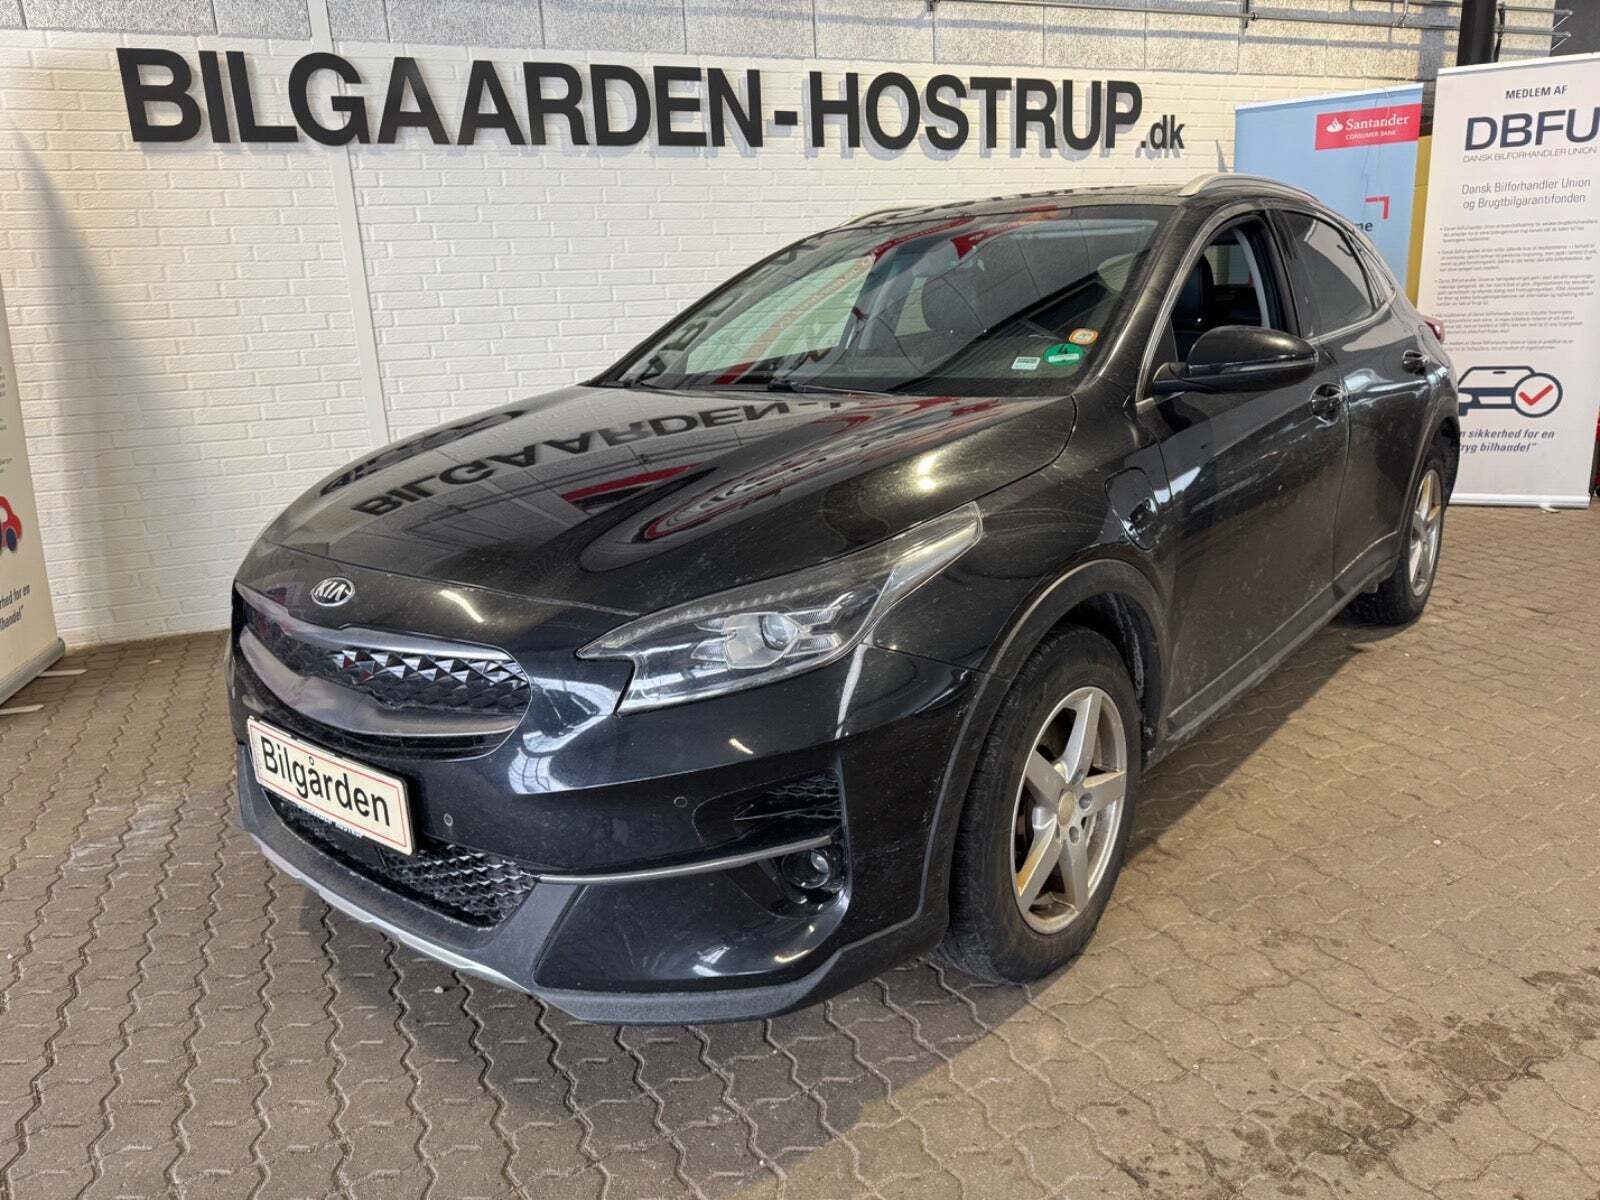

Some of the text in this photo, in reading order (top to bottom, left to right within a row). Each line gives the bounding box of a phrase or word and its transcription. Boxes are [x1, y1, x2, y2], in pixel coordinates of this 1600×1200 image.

[1504, 84, 1568, 100] MEDLEM AF
[1345, 113, 1410, 131] Santander
[1464, 105, 1600, 151] DBFU
[1462, 145, 1598, 164] DANSK BILFORHANDLER UNION
[1461, 176, 1591, 195] Dansk Bilforhandler Union
[1462, 199, 1475, 210] og
[1467, 428, 1523, 438] sikkerhed
[1524, 428, 1539, 438] for
[1541, 430, 1555, 438] en
[1459, 442, 1478, 453] ryg
[313, 579, 347, 601] KIA
[260, 735, 391, 827] Bilgården
